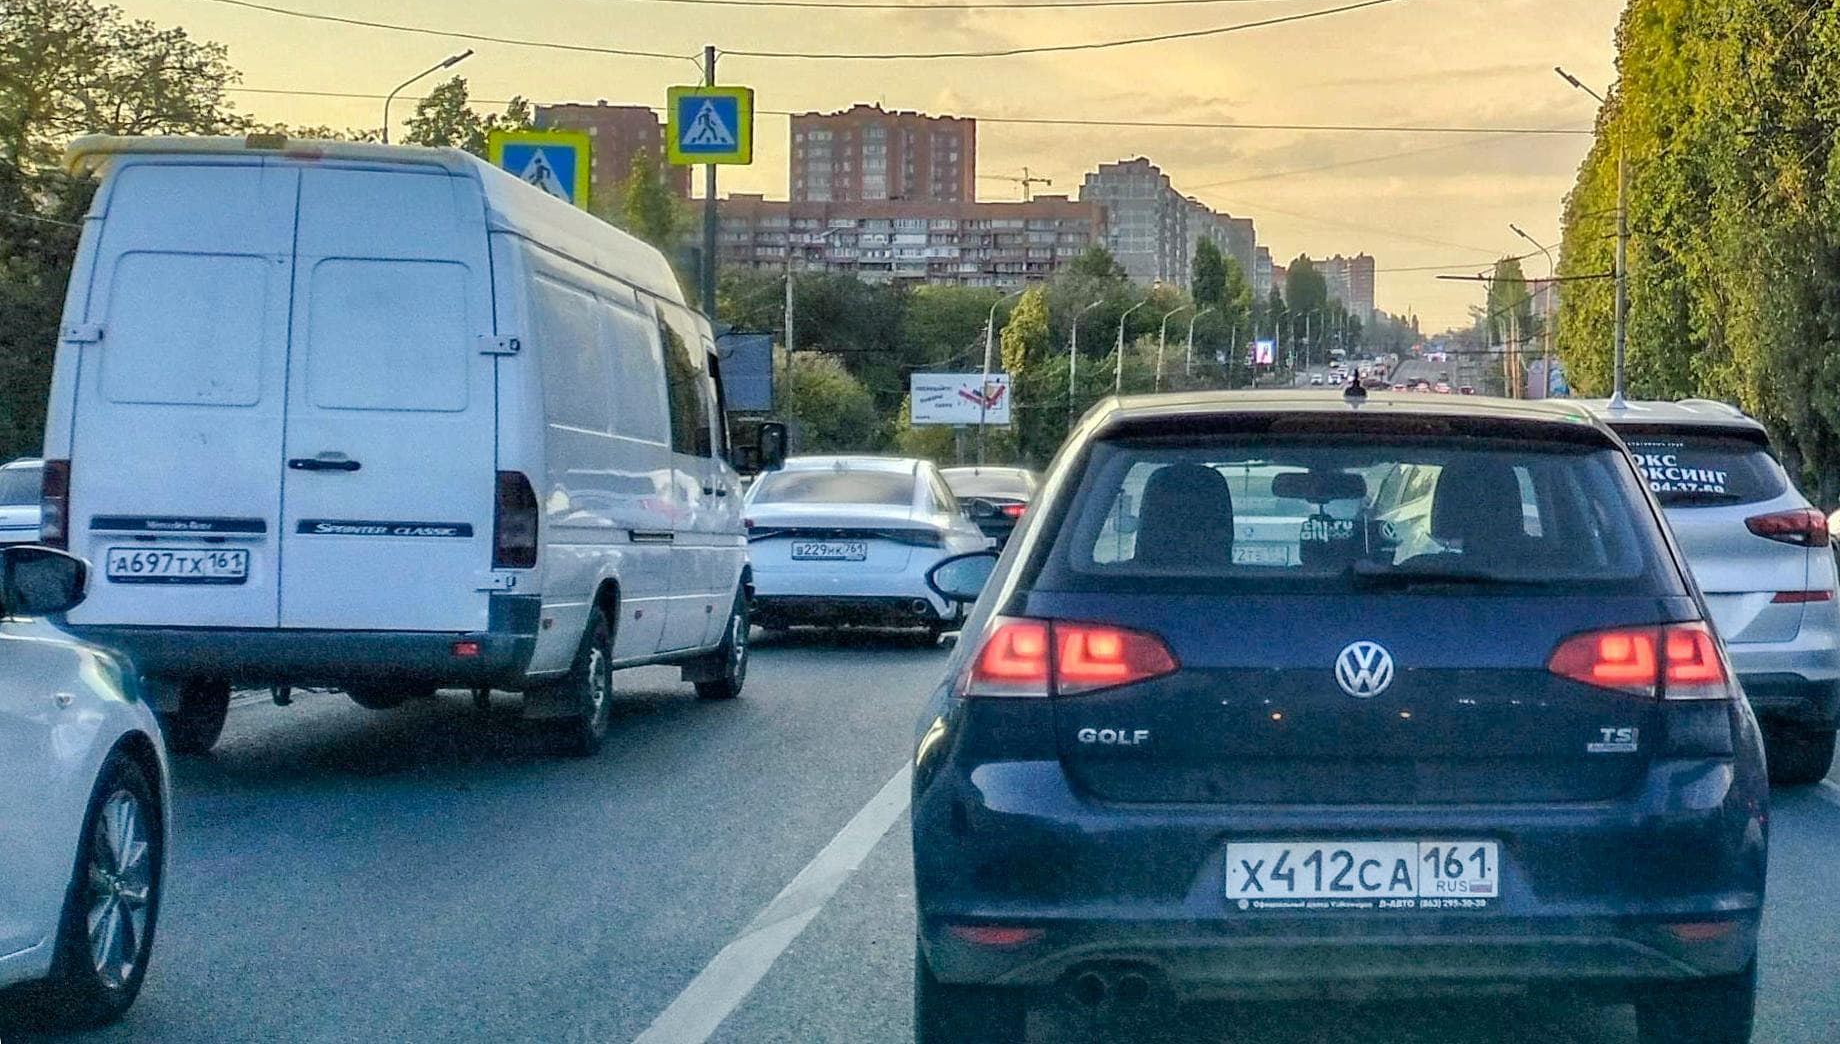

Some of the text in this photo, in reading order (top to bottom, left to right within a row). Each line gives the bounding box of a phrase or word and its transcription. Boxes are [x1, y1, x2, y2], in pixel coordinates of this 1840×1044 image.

[114, 553, 243, 573] А697ТХ 161
[1077, 727, 1150, 745] GOLF
[1239, 846, 1488, 892] Х412СА 161
[1435, 880, 1468, 893] RUS
